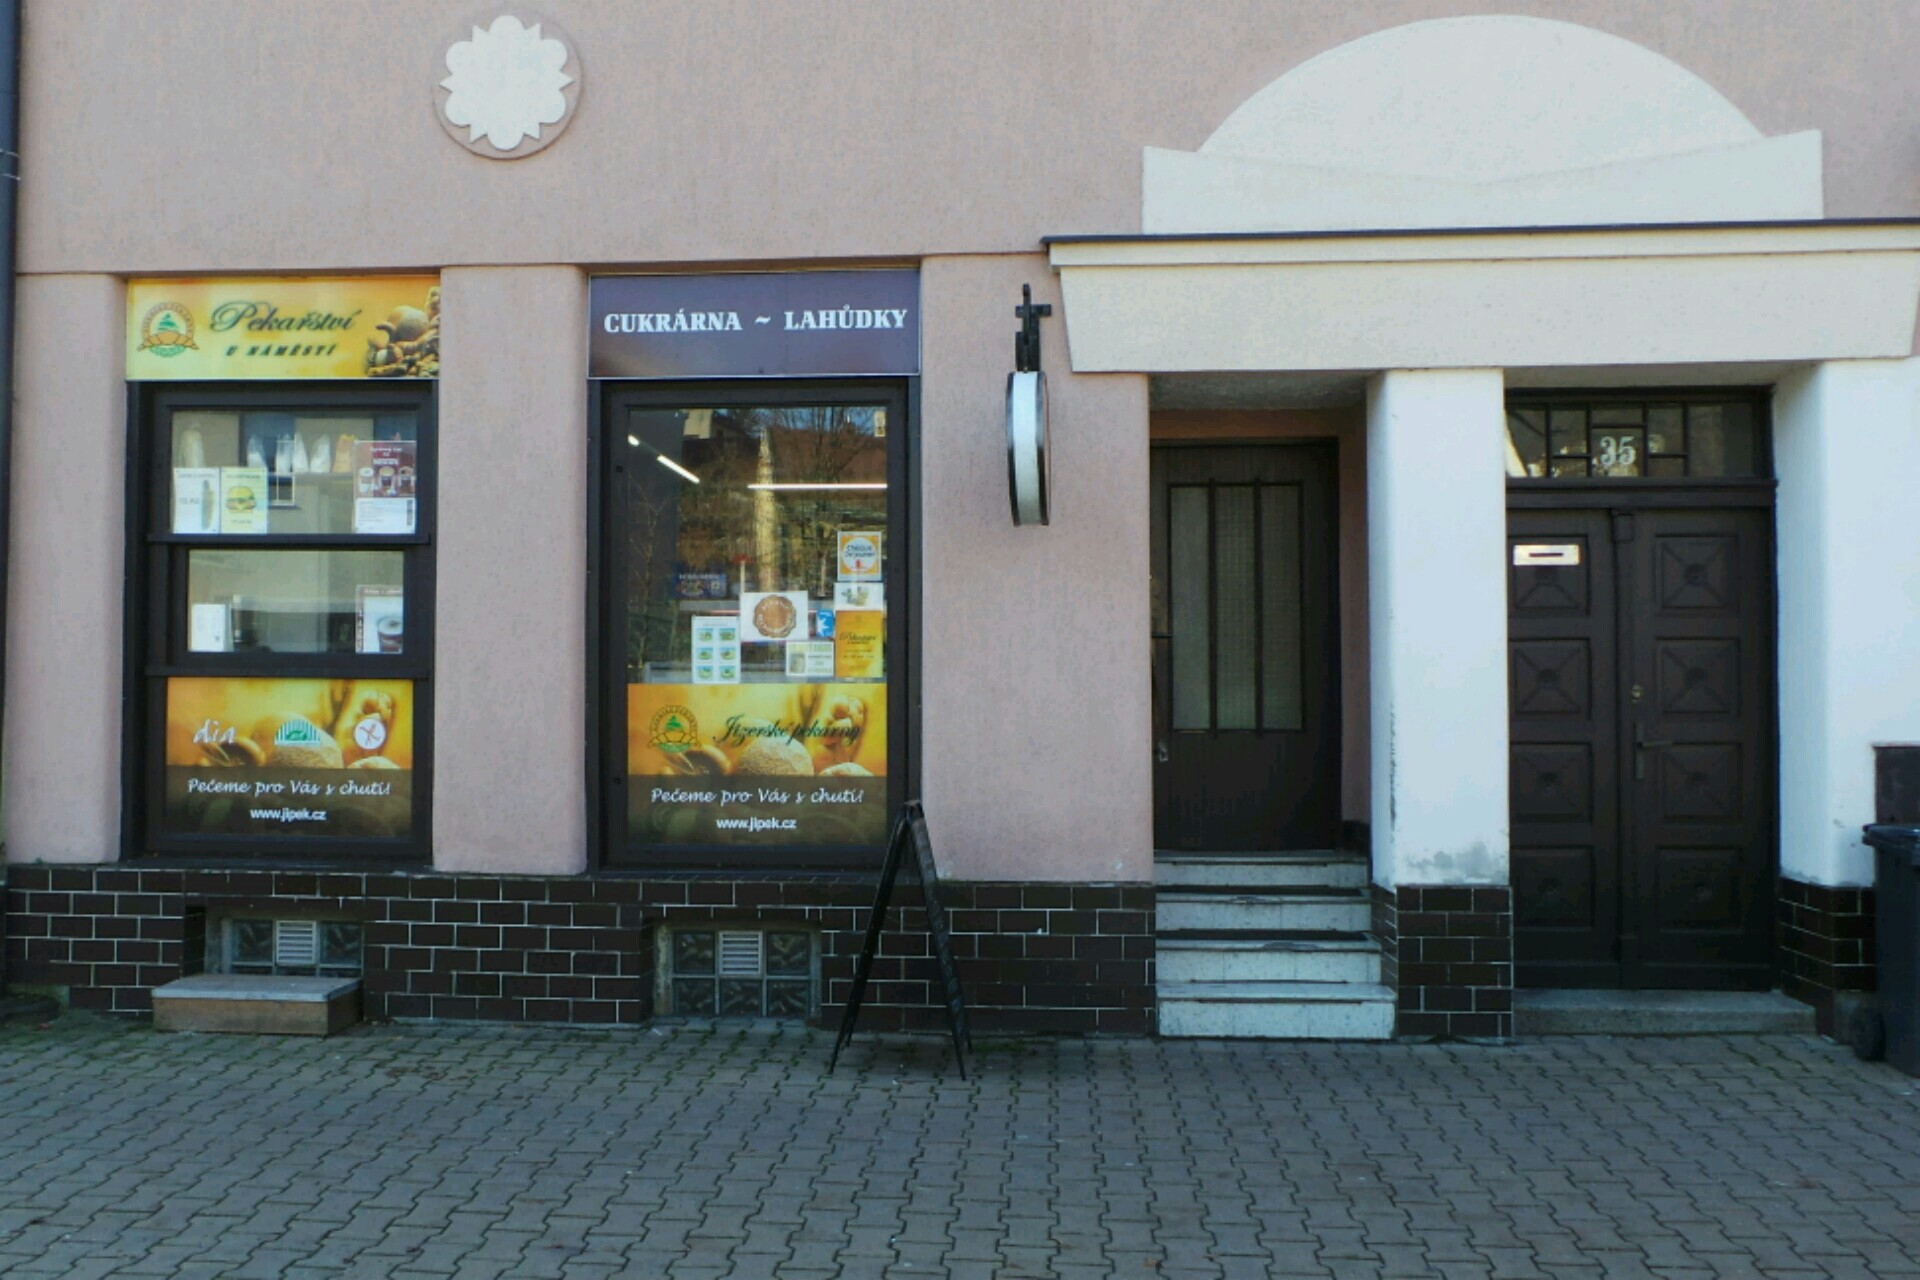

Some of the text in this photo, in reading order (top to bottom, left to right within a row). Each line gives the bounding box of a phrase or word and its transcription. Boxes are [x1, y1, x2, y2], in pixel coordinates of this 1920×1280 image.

[603, 308, 743, 333] CUKRÁRNA
[784, 304, 908, 330] LAHŮDKY
[1600, 436, 1636, 467] 35
[193, 718, 237, 745] dia
[187, 778, 391, 797] Pečeme pro Vás s chutí!
[651, 787, 864, 807] Pečeme pro Vás s chutí!
